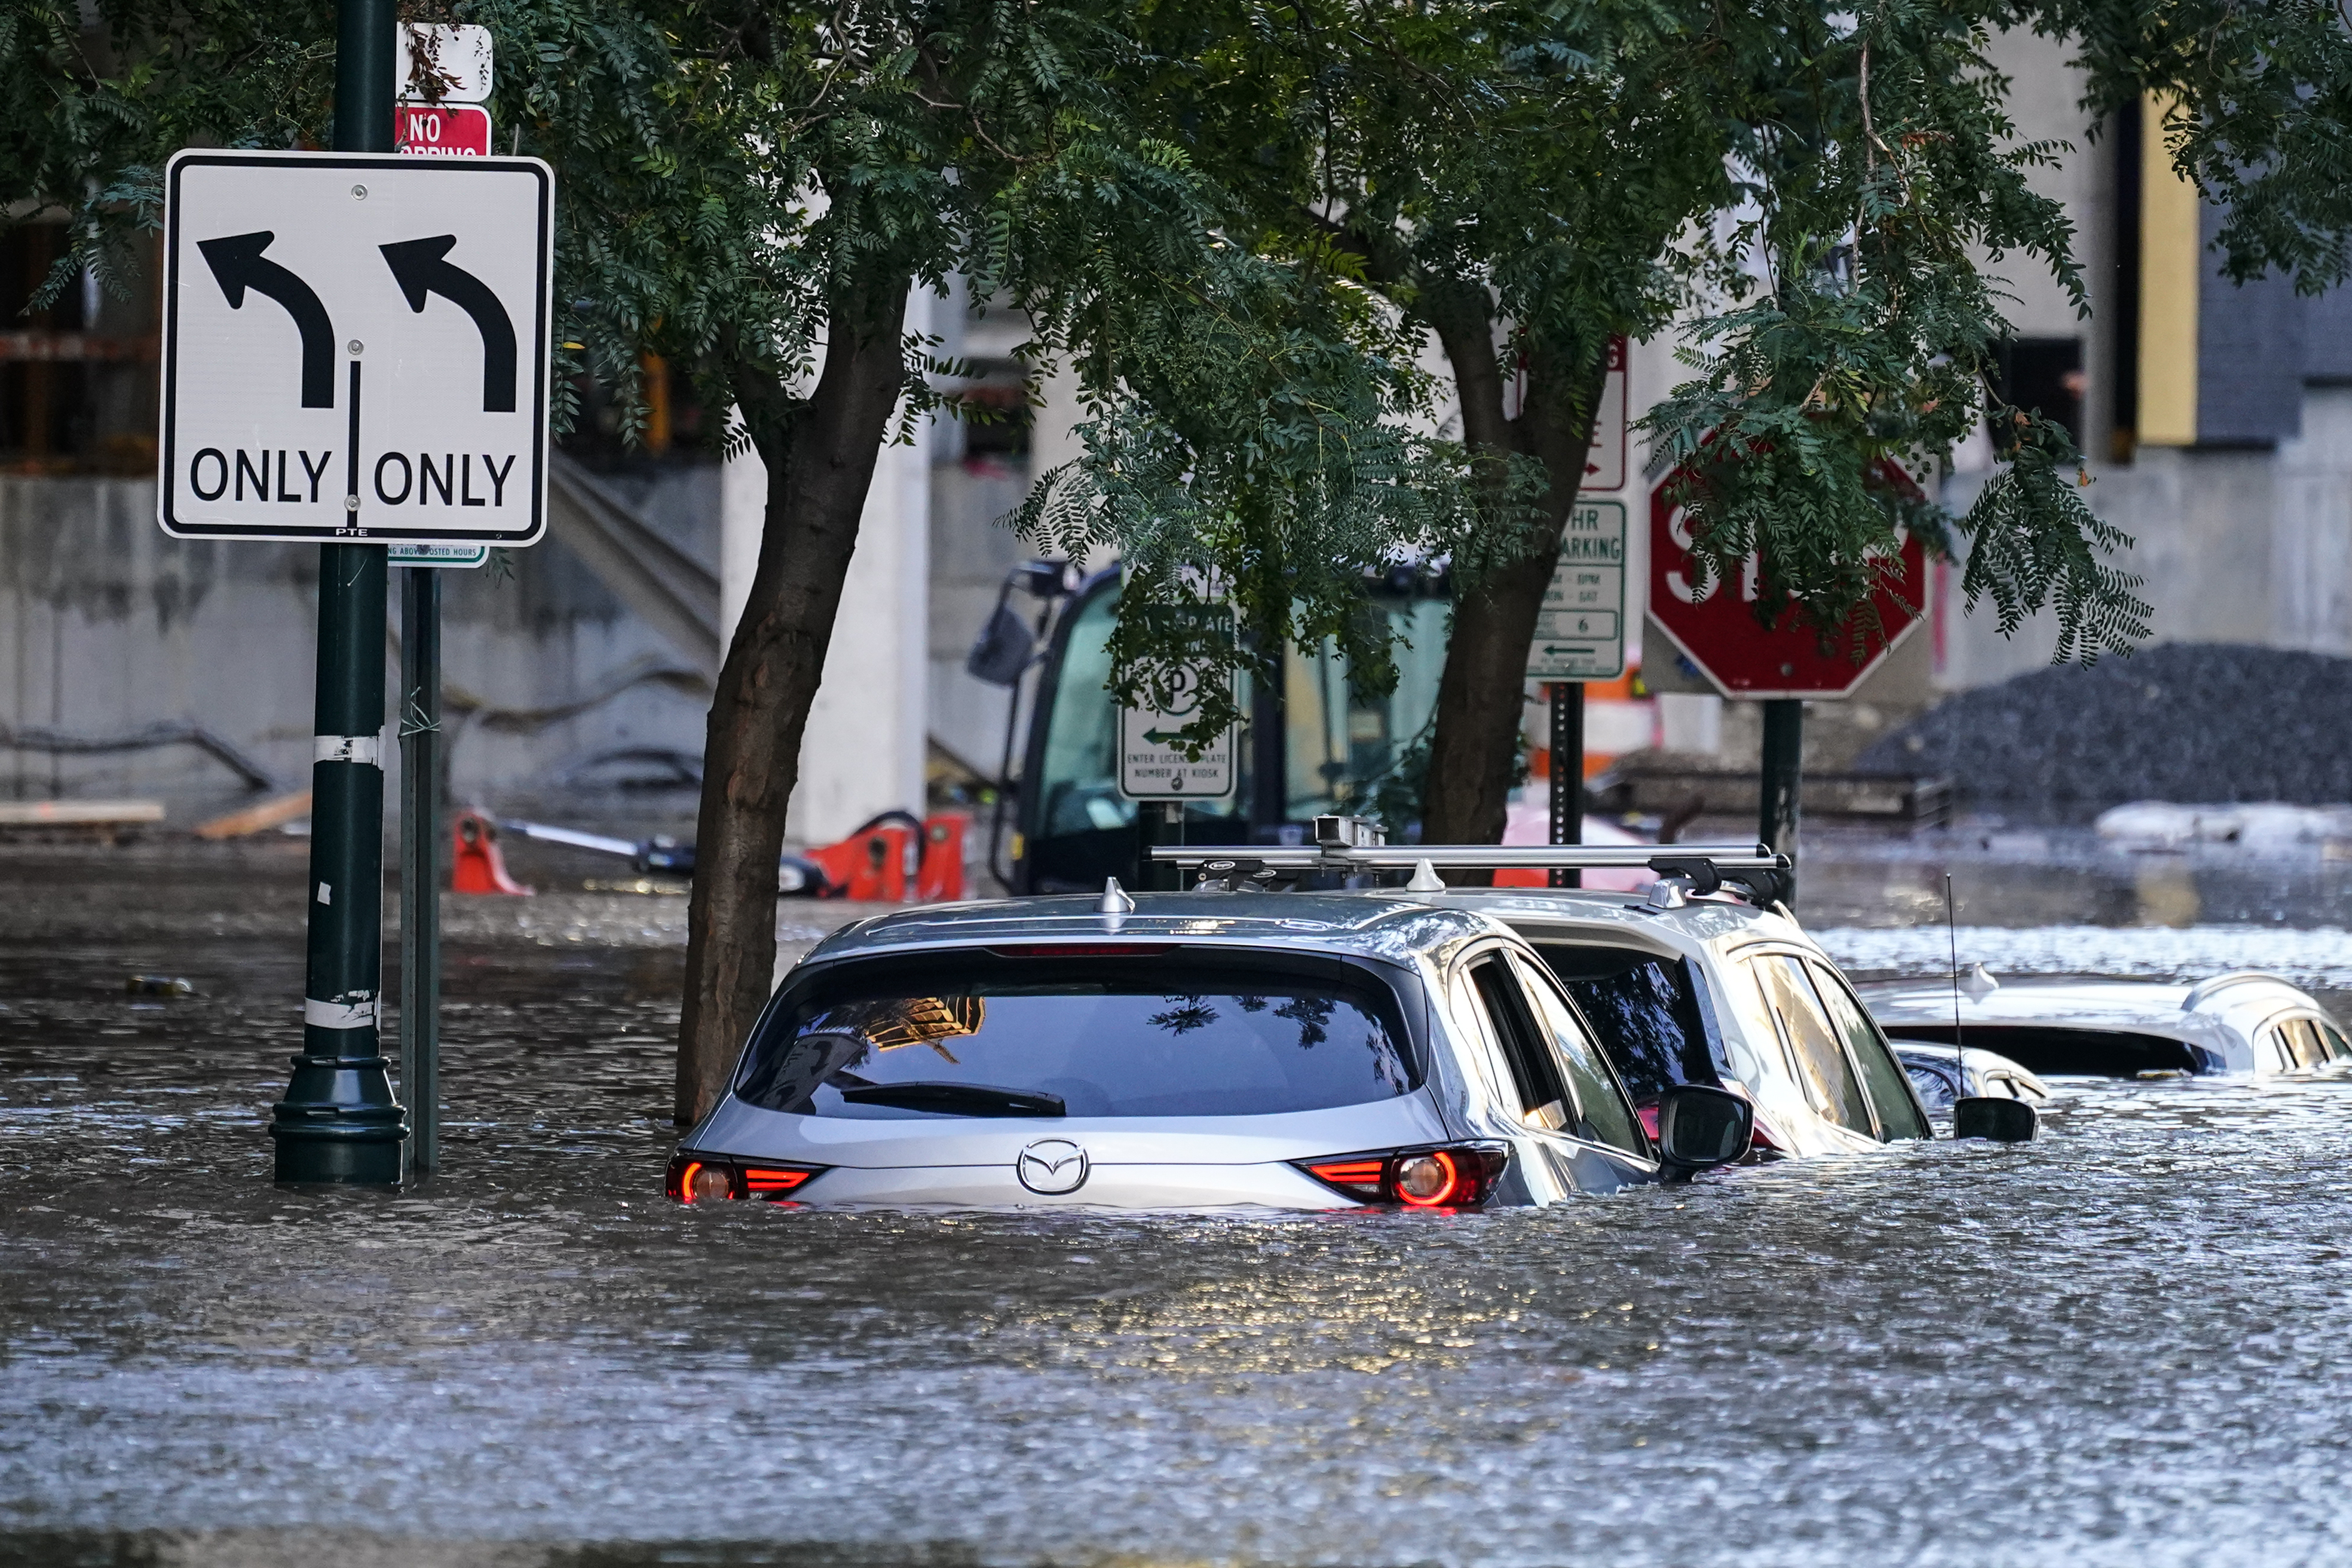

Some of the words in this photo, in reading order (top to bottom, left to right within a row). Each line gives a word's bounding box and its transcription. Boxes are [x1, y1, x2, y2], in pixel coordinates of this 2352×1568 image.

[410, 113, 441, 142] NO
[190, 448, 332, 503] ONLY
[374, 452, 516, 507] ONLY
[1571, 509, 1599, 531] HR
[336, 528, 368, 537] PTE
[1560, 537, 1621, 560] ARKING
[1128, 754, 1155, 764] ENTER
[1159, 754, 1192, 764] LICEN
[1135, 767, 1172, 778] NUMBER
[1177, 767, 1187, 778] AT
